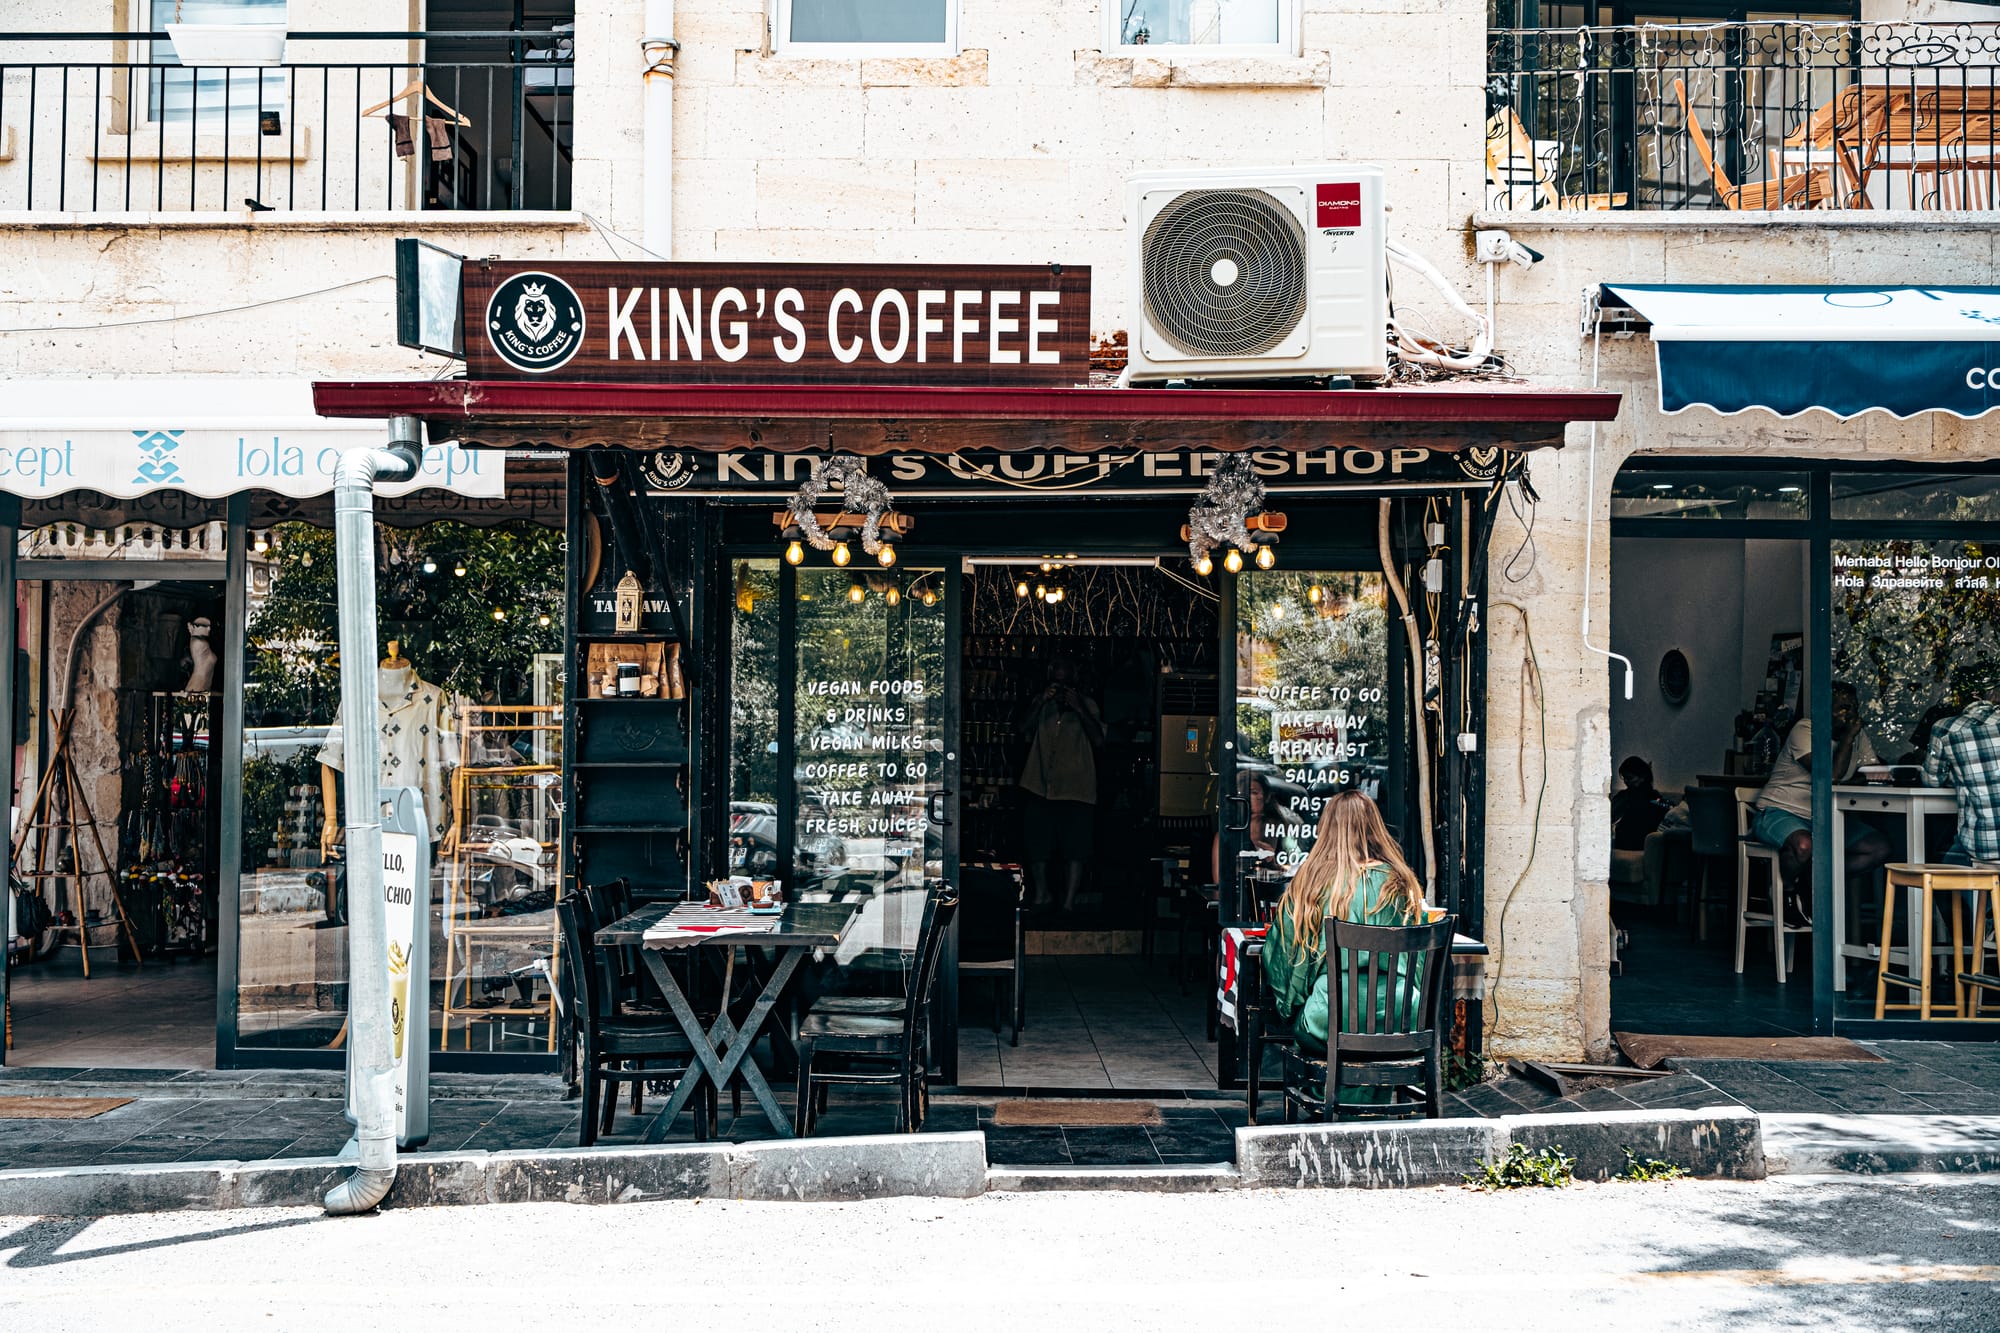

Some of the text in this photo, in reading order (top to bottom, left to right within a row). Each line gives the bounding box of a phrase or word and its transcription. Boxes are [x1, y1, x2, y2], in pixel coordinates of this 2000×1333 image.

[608, 286, 1060, 364] KING'S COFFEE
[505, 330, 567, 355] KING'S COFFEE
[237, 436, 304, 477] lola
[1251, 448, 1430, 476] SHOP
[668, 470, 690, 487] COFFEE
[1834, 555, 1891, 568] Merhaba
[1895, 555, 1928, 568] Hello
[1931, 555, 1982, 573] Bonjour
[1834, 575, 1864, 588] Hola
[1872, 575, 1943, 589] Здравейте
[808, 680, 924, 696] VEGAN FOODS
[1257, 686, 1381, 702] COFFEE TO GO
[826, 708, 837, 723] &
[1273, 714, 1367, 730] TAKE AWAY
[810, 736, 863, 751] VEGAN
[1268, 742, 1368, 757] BREAKFAST
[805, 762, 927, 779] COFFEE TO GO
[1285, 768, 1350, 785] SALADS
[820, 790, 914, 806] TAKE AWAY
[806, 818, 860, 833] FRESH
